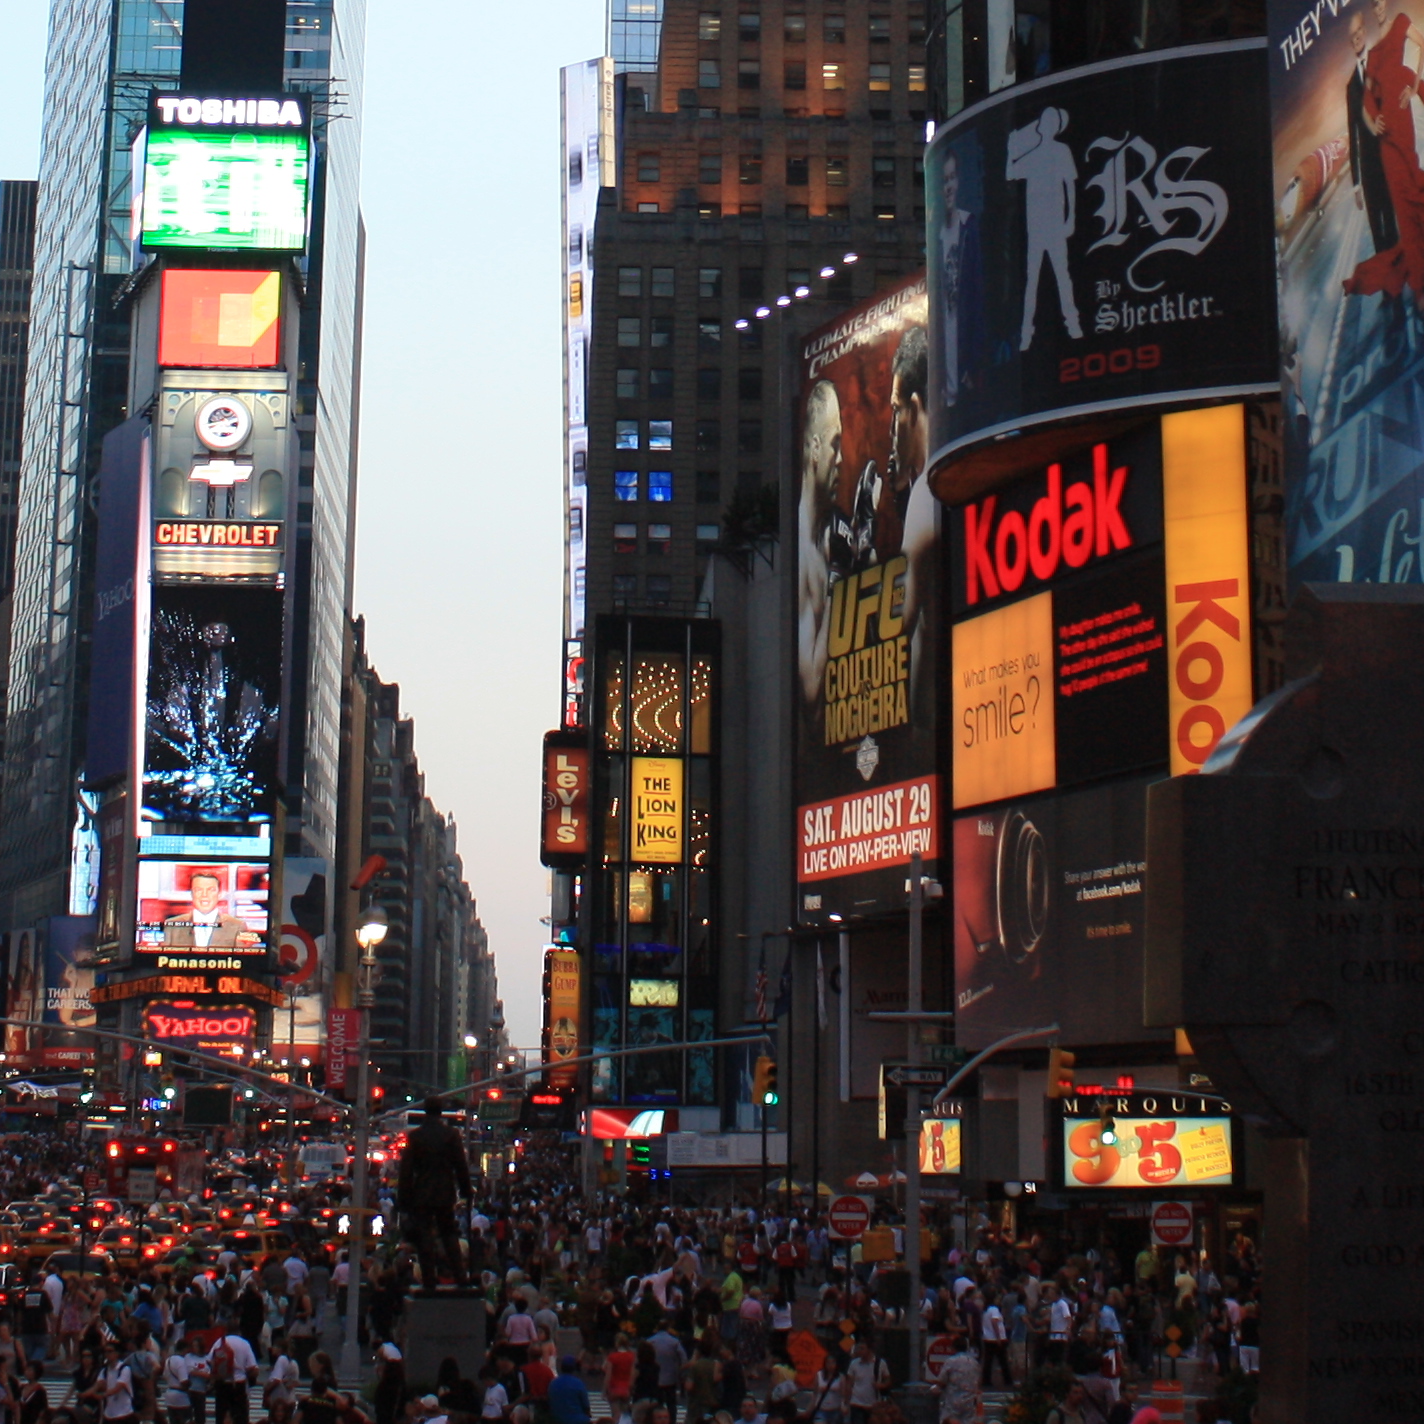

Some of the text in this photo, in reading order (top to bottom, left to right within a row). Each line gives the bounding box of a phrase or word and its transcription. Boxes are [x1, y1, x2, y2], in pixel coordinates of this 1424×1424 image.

[157, 98, 302, 125] TOSHIBA
[1095, 280, 1120, 301] By
[1094, 295, 1214, 334] Sheckler
[804, 313, 864, 359] ULTIMATE
[1059, 344, 1161, 383] 2009
[157, 523, 279, 545] CHEVROLET
[965, 442, 1132, 606] Kodak
[829, 556, 907, 658] UFC
[827, 636, 908, 703] COUTURE
[963, 653, 1041, 688] What you
[826, 680, 908, 745] NOGUEIRA
[964, 674, 1042, 750] smile?
[643, 778, 670, 791] THE
[638, 796, 676, 819] LION
[804, 784, 930, 847] SAT. AUGUST 29
[637, 823, 676, 847] KING
[804, 828, 931, 874] LIVE ON PAY-PER-VIEW
[158, 956, 241, 969] Panasonic
[555, 976, 576, 991] GUMP
[149, 1015, 250, 1037] YAHOO!
[331, 1013, 346, 1084] WELCOME
[1069, 1121, 1182, 1184] 9 5
[1351, 1186, 1369, 1209] A
[1159, 1210, 1185, 1218] DO NOT
[1160, 1228, 1184, 1236] ENTER
[1341, 1245, 1406, 1267] GOD
